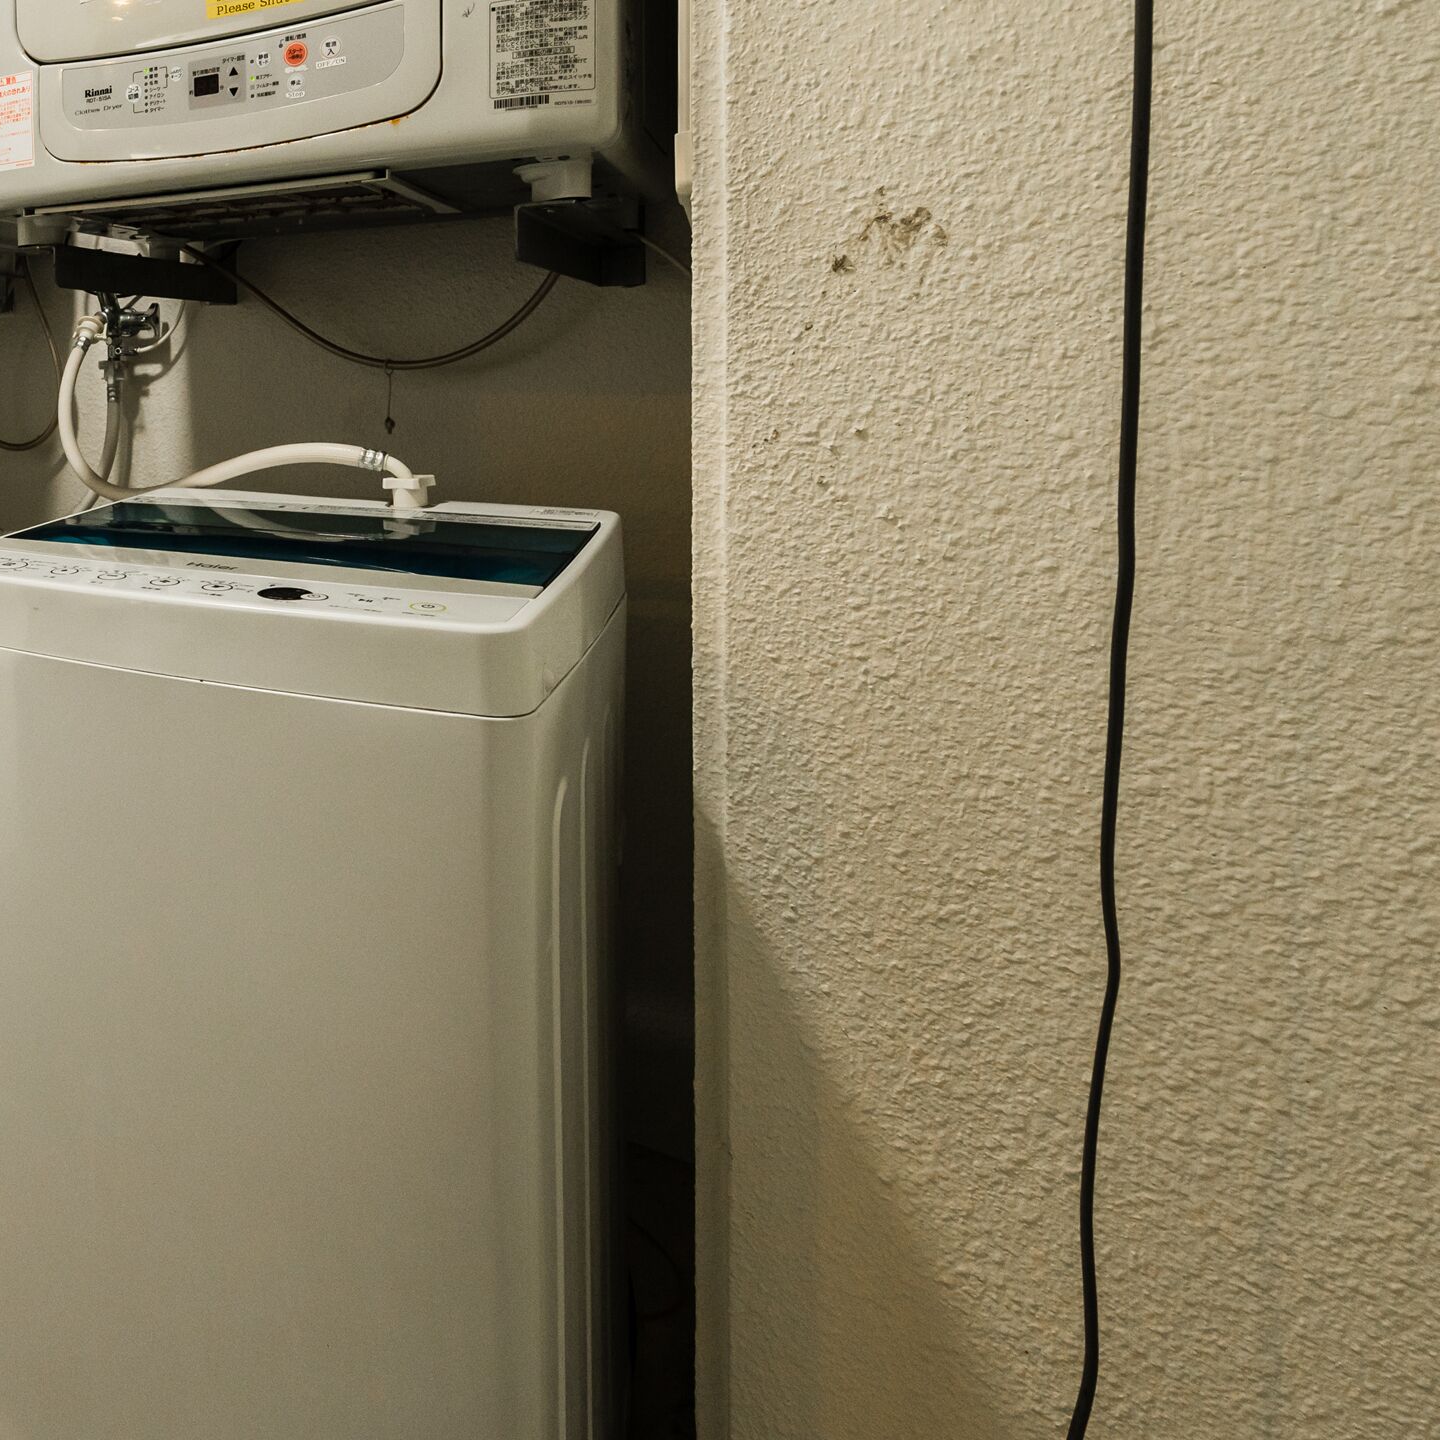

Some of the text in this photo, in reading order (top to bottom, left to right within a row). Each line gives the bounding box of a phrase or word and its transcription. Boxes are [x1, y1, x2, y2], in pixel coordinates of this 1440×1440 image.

[216, 2, 255, 15] Please
[84, 86, 112, 98] Rinnai
[104, 104, 123, 112] Dryer
